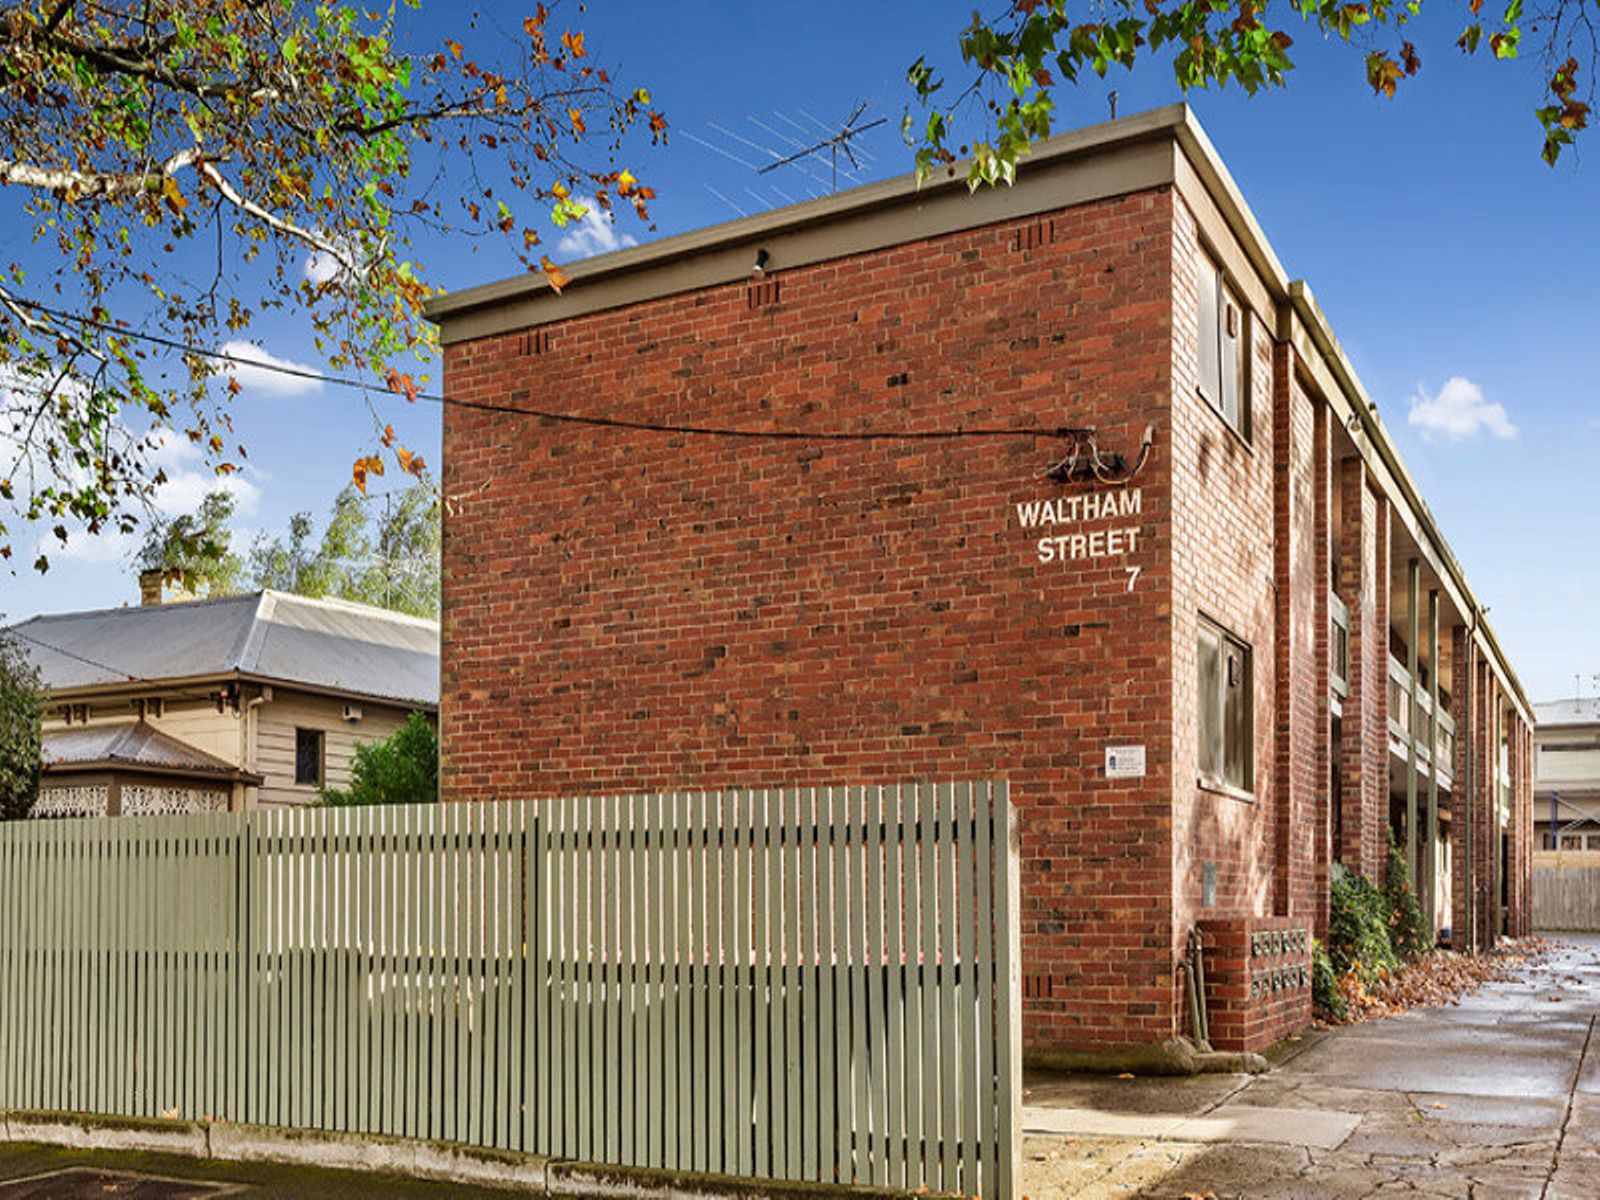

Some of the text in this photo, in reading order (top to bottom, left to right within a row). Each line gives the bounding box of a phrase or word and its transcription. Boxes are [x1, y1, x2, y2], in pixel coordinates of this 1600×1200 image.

[1016, 488, 1142, 528] WALTHAM
[1037, 526, 1140, 563] STREET
[1125, 566, 1141, 592] 7
